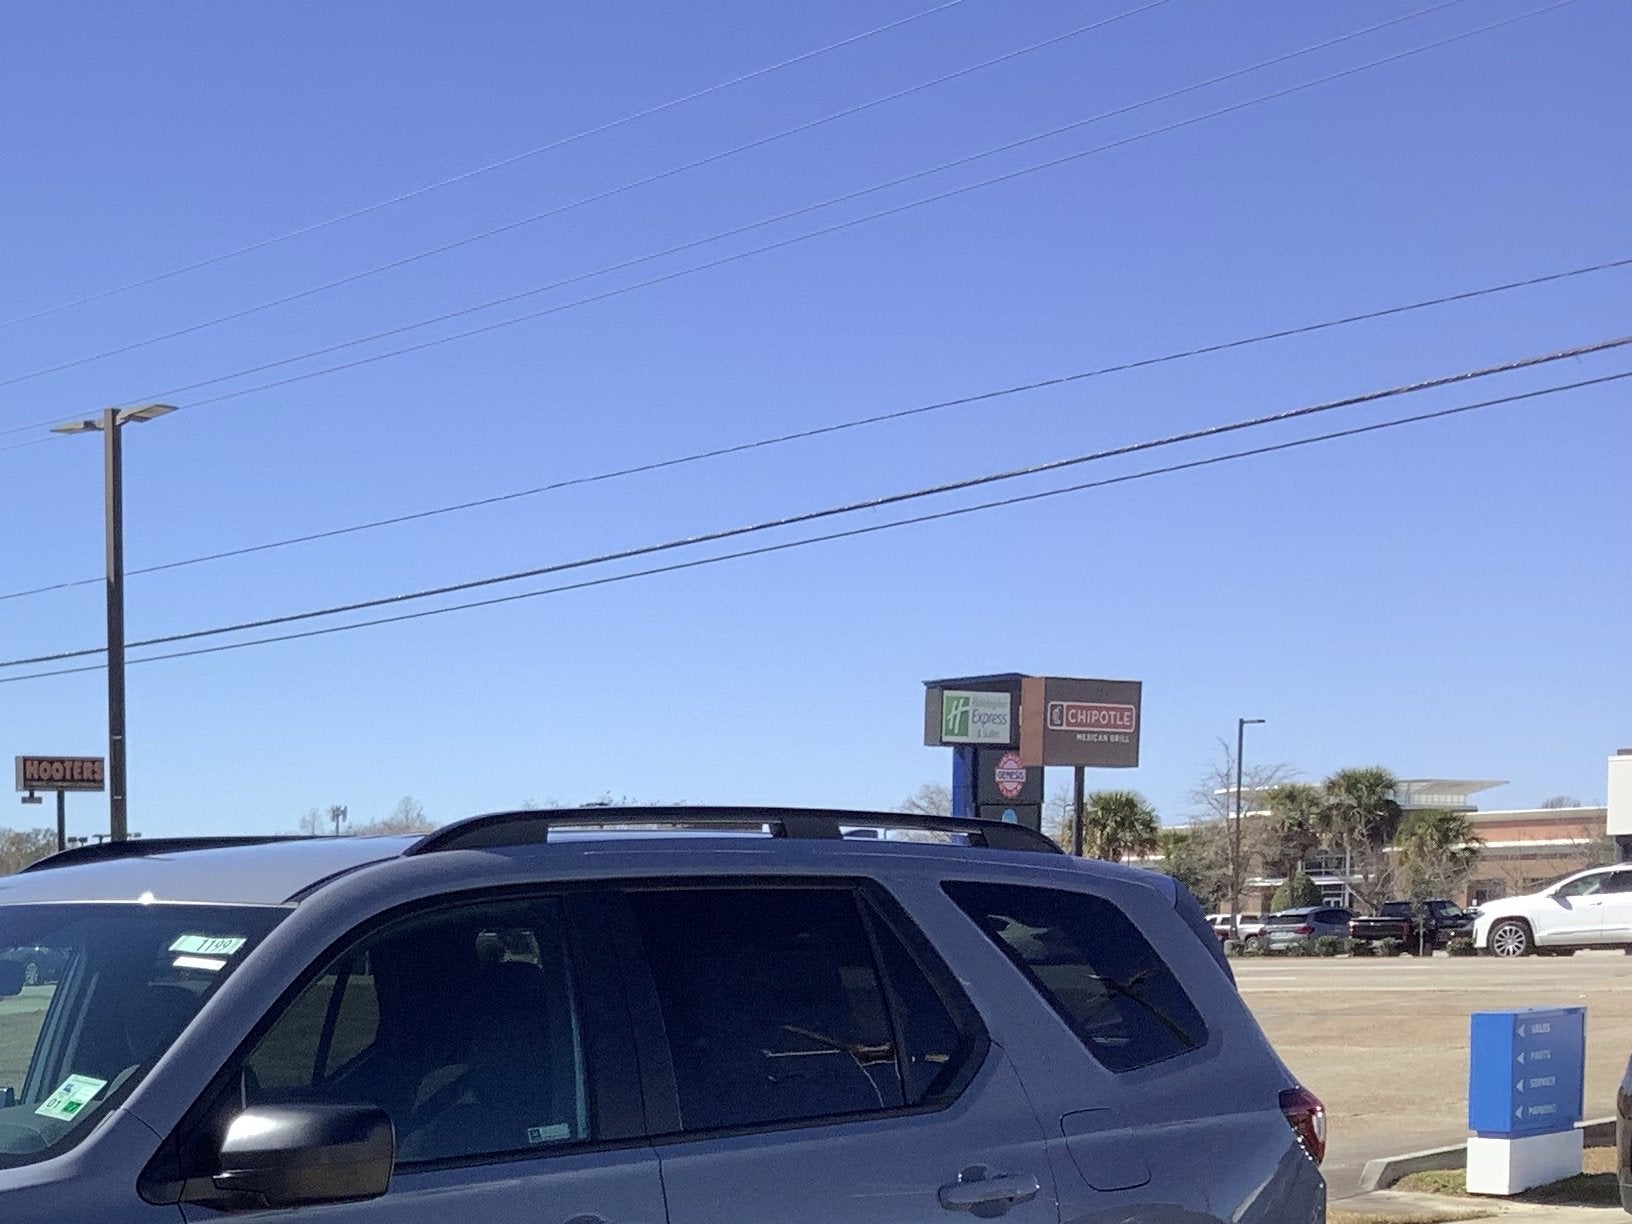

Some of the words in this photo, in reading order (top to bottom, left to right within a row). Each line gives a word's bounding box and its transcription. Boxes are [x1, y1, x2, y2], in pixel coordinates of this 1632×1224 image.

[971, 709, 1008, 728] Express
[1068, 709, 1132, 726] CHIPOTLE
[1076, 733, 1108, 743] MEXICAN
[1110, 734, 1130, 743] GRILL
[25, 760, 102, 780] HOOTERS
[196, 939, 233, 953] 1199
